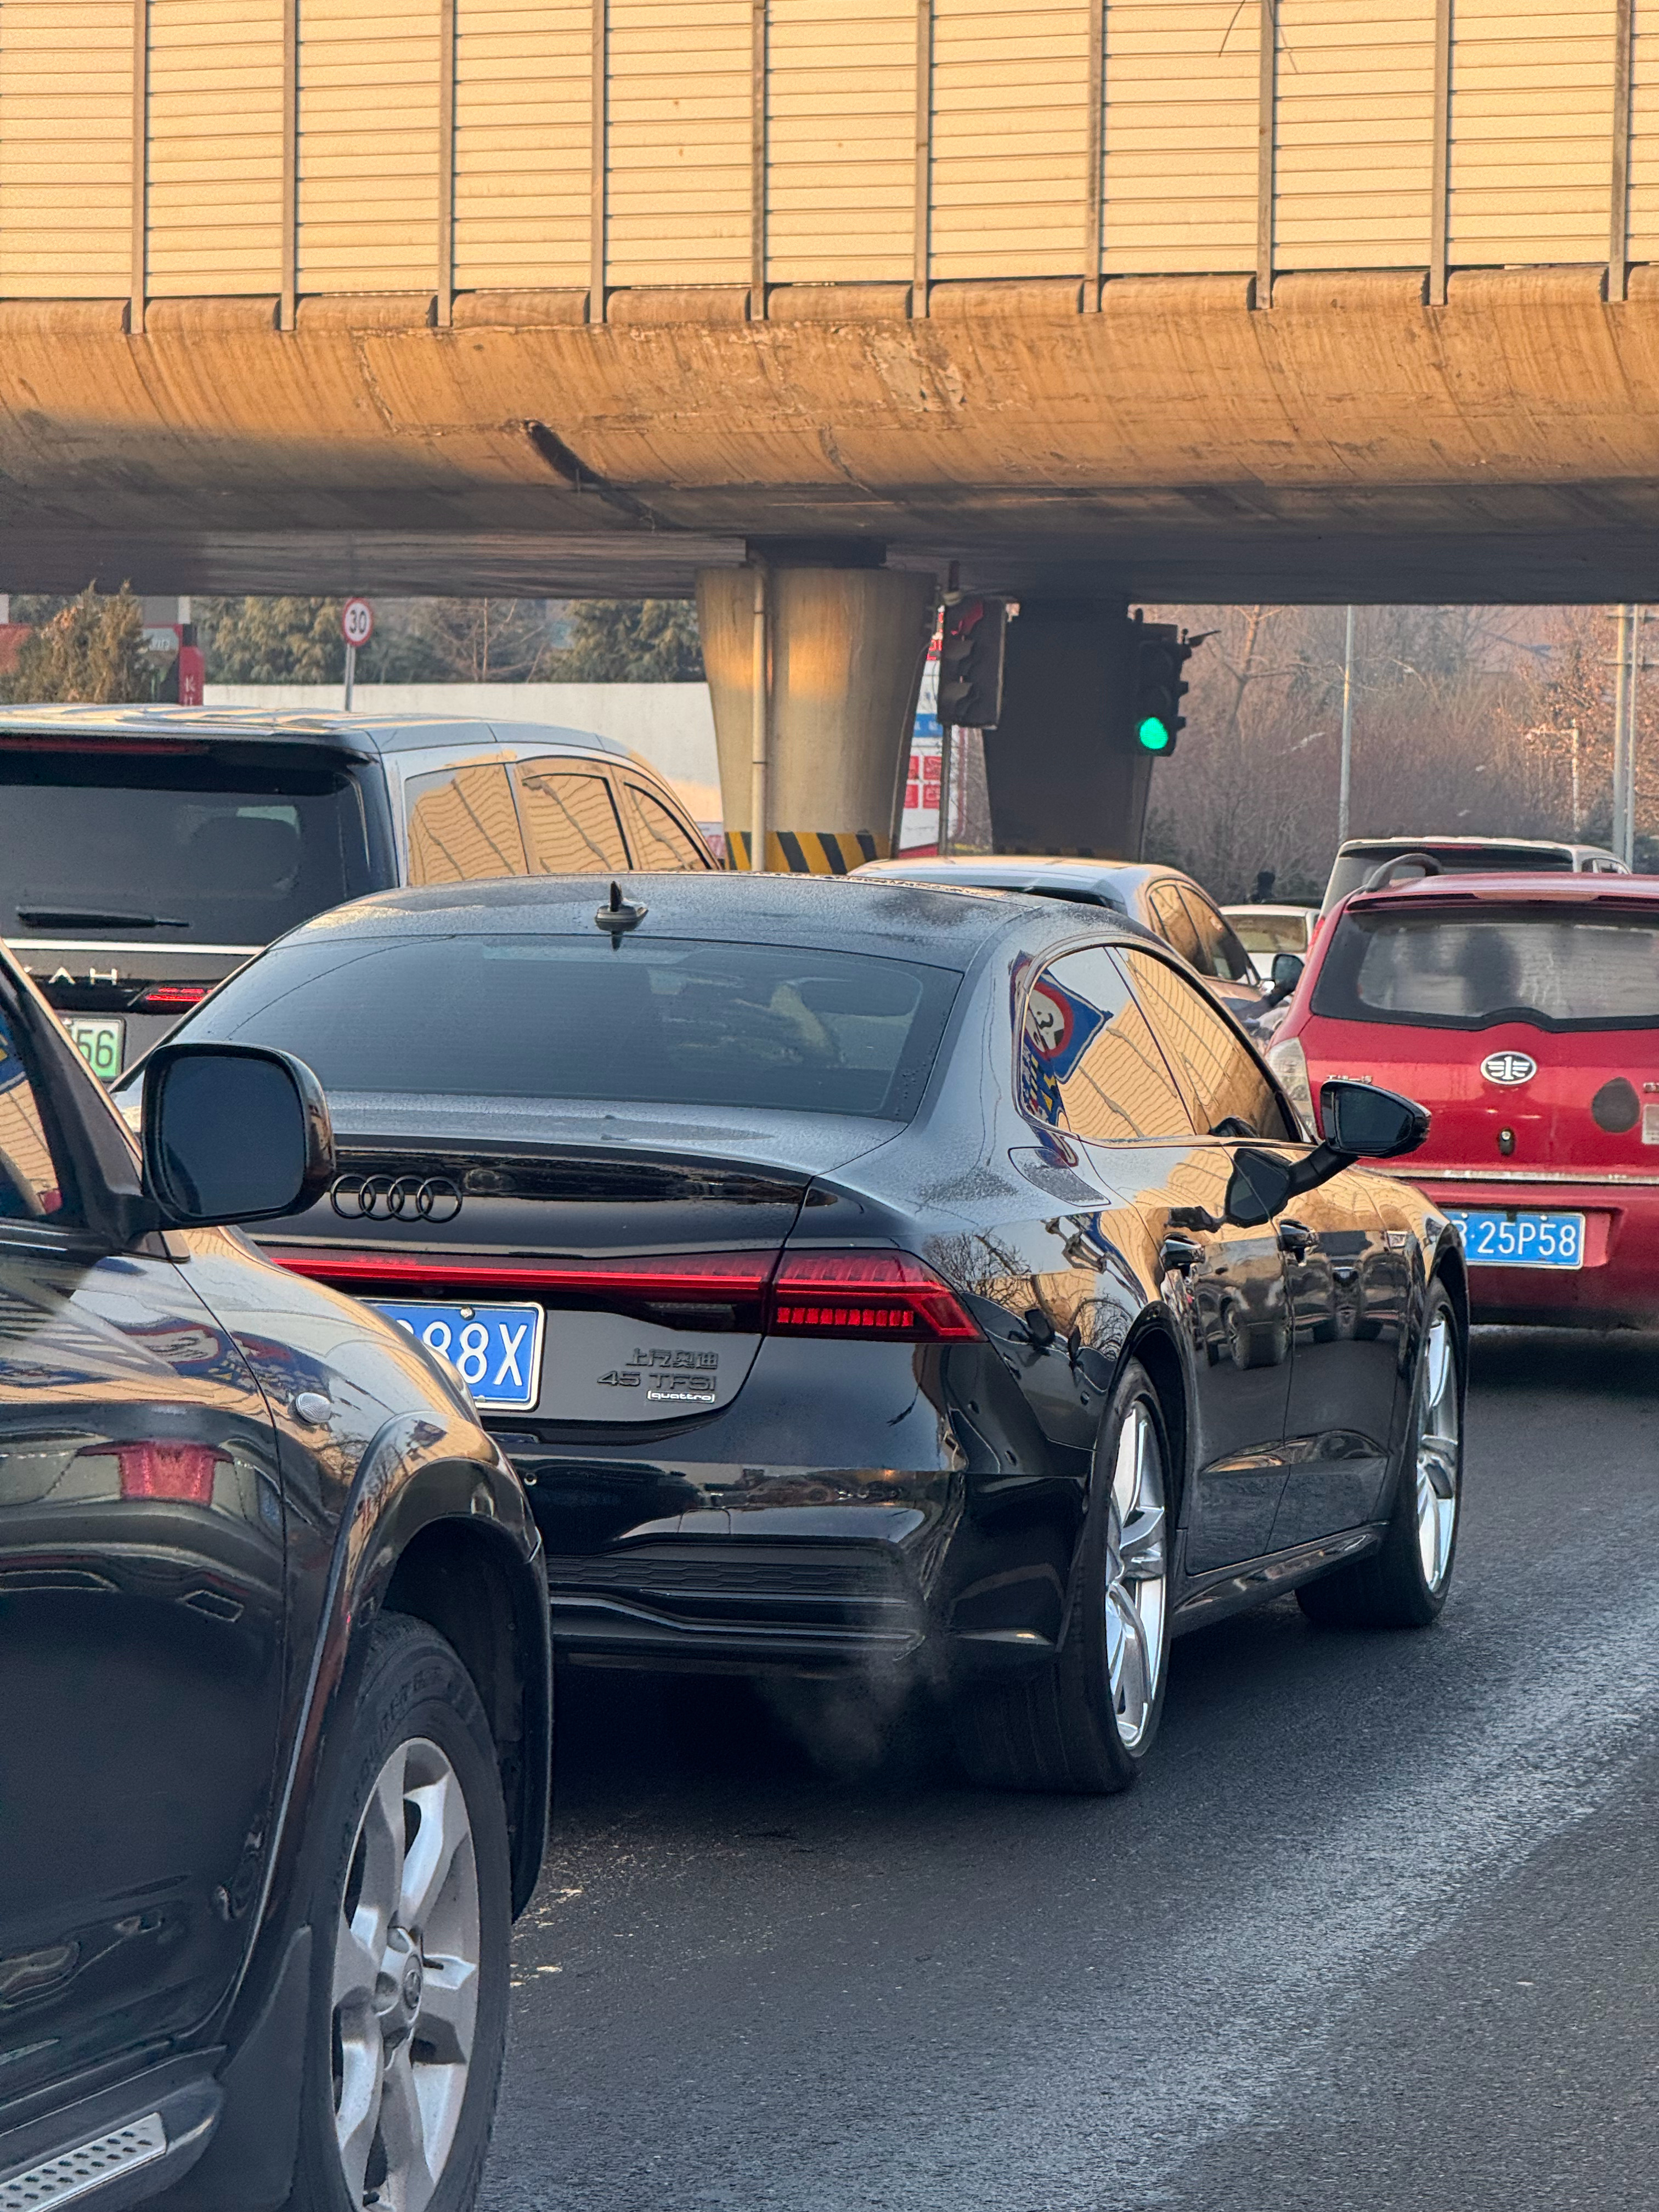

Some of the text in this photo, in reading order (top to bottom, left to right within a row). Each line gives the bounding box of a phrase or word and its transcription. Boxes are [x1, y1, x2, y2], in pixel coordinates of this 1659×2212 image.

[349, 610, 367, 634] 30
[396, 1318, 528, 1386] 88X
[625, 1347, 719, 1370] 上汽奥迪
[597, 1370, 717, 1391] 45 TFSI
[650, 1391, 714, 1402] quattro
